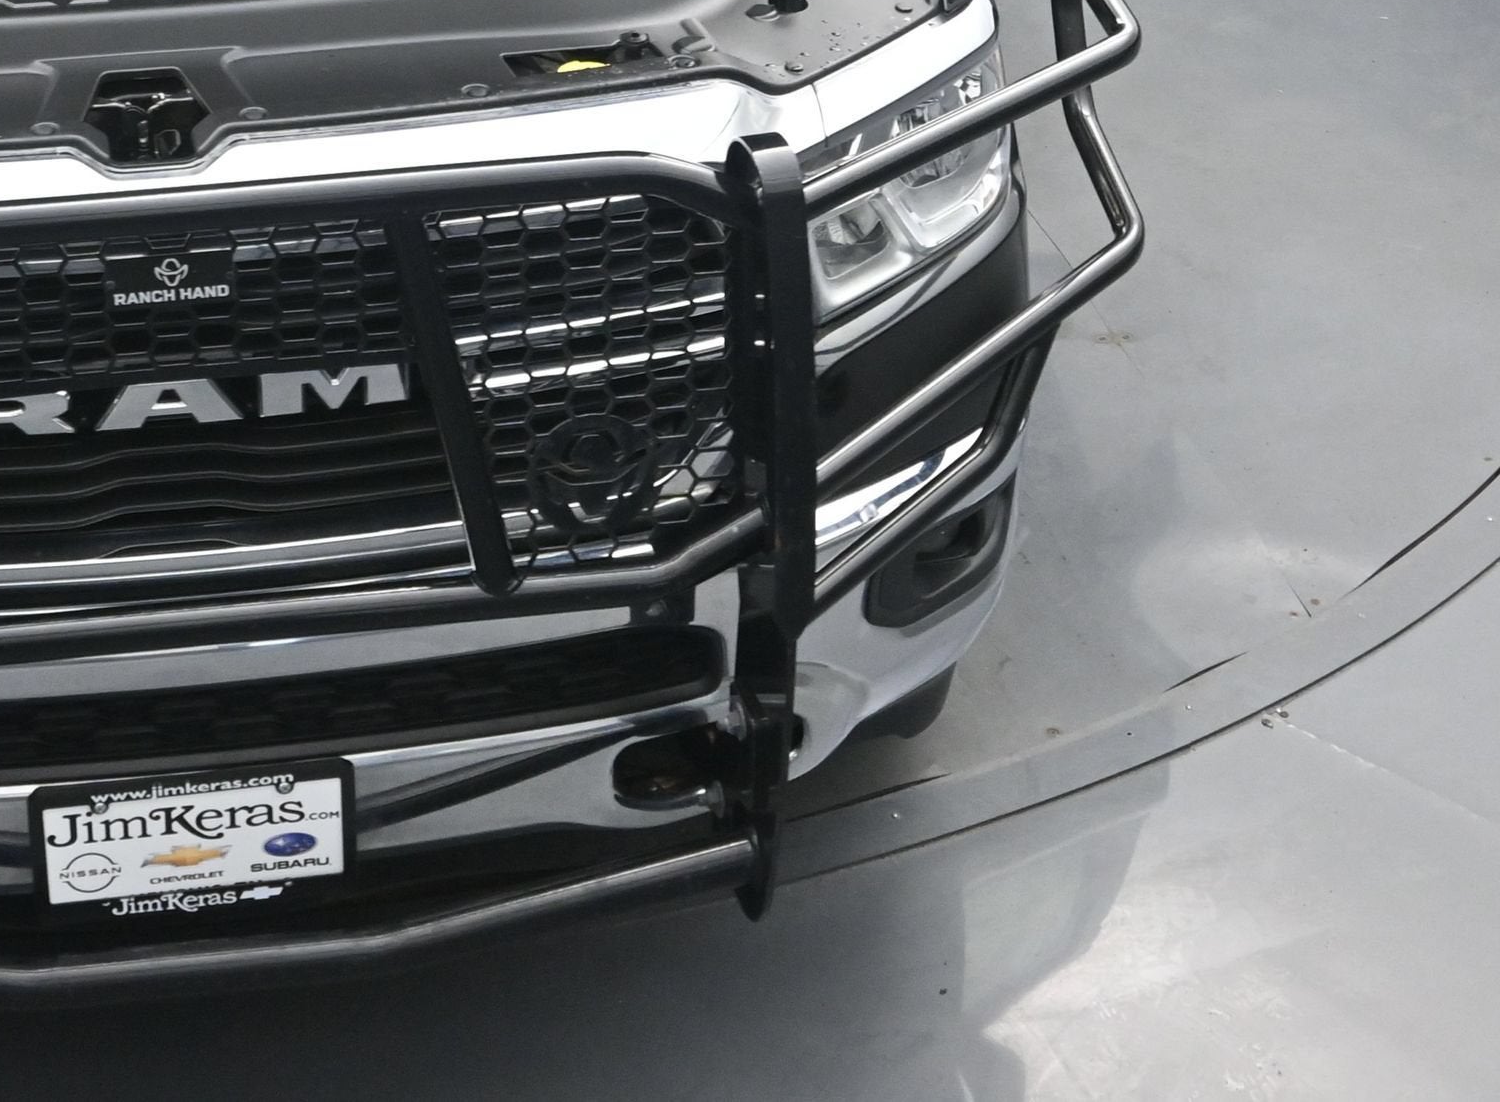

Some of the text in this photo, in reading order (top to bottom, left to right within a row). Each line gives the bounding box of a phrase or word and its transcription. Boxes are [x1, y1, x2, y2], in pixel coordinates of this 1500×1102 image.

[113, 284, 230, 306] RANCH HAND
[90, 773, 294, 803] www.jimkeras.com
[59, 866, 122, 879] NISSAN
[250, 857, 331, 873] SUBARU
[150, 870, 225, 885] CHEVROLET
